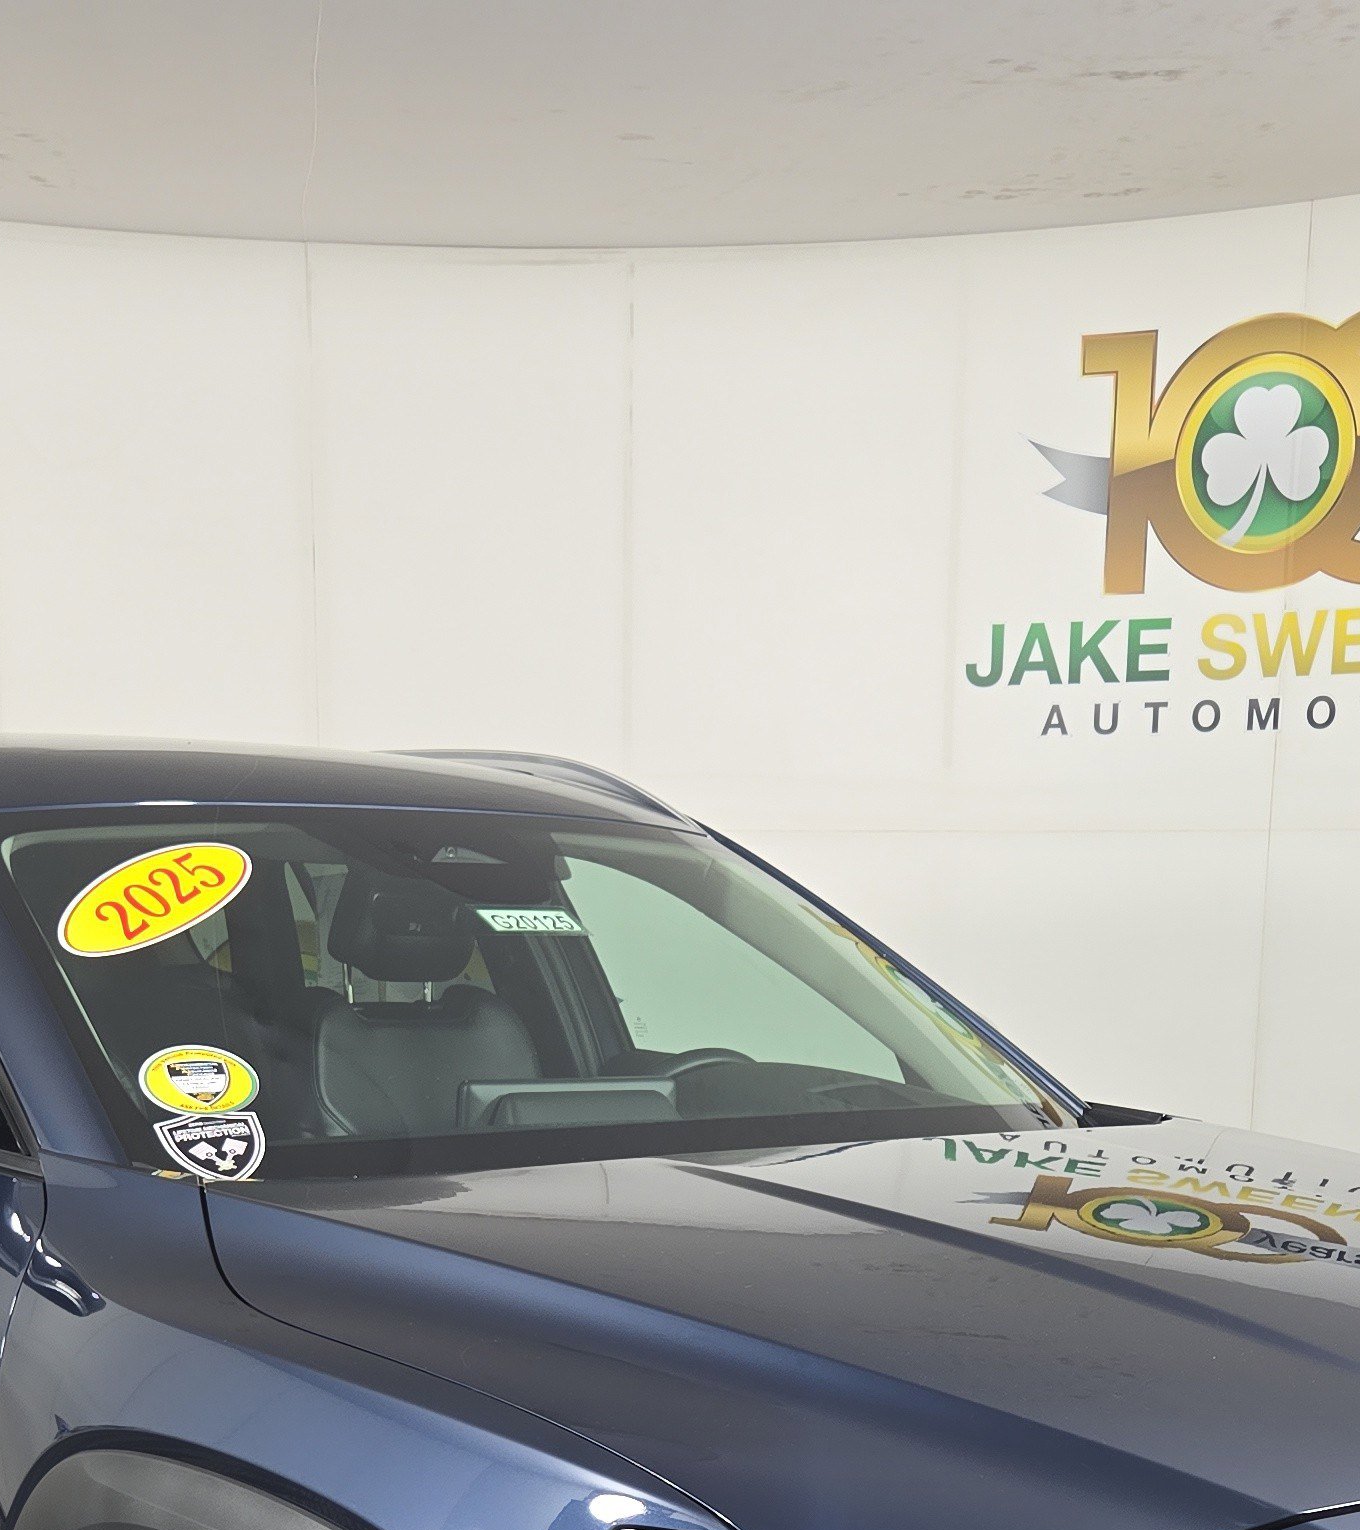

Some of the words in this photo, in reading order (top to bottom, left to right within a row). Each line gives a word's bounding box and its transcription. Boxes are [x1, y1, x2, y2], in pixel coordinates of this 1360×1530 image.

[965, 617, 1173, 688] JAKE
[95, 852, 226, 940] 2025
[491, 914, 574, 930] G20125
